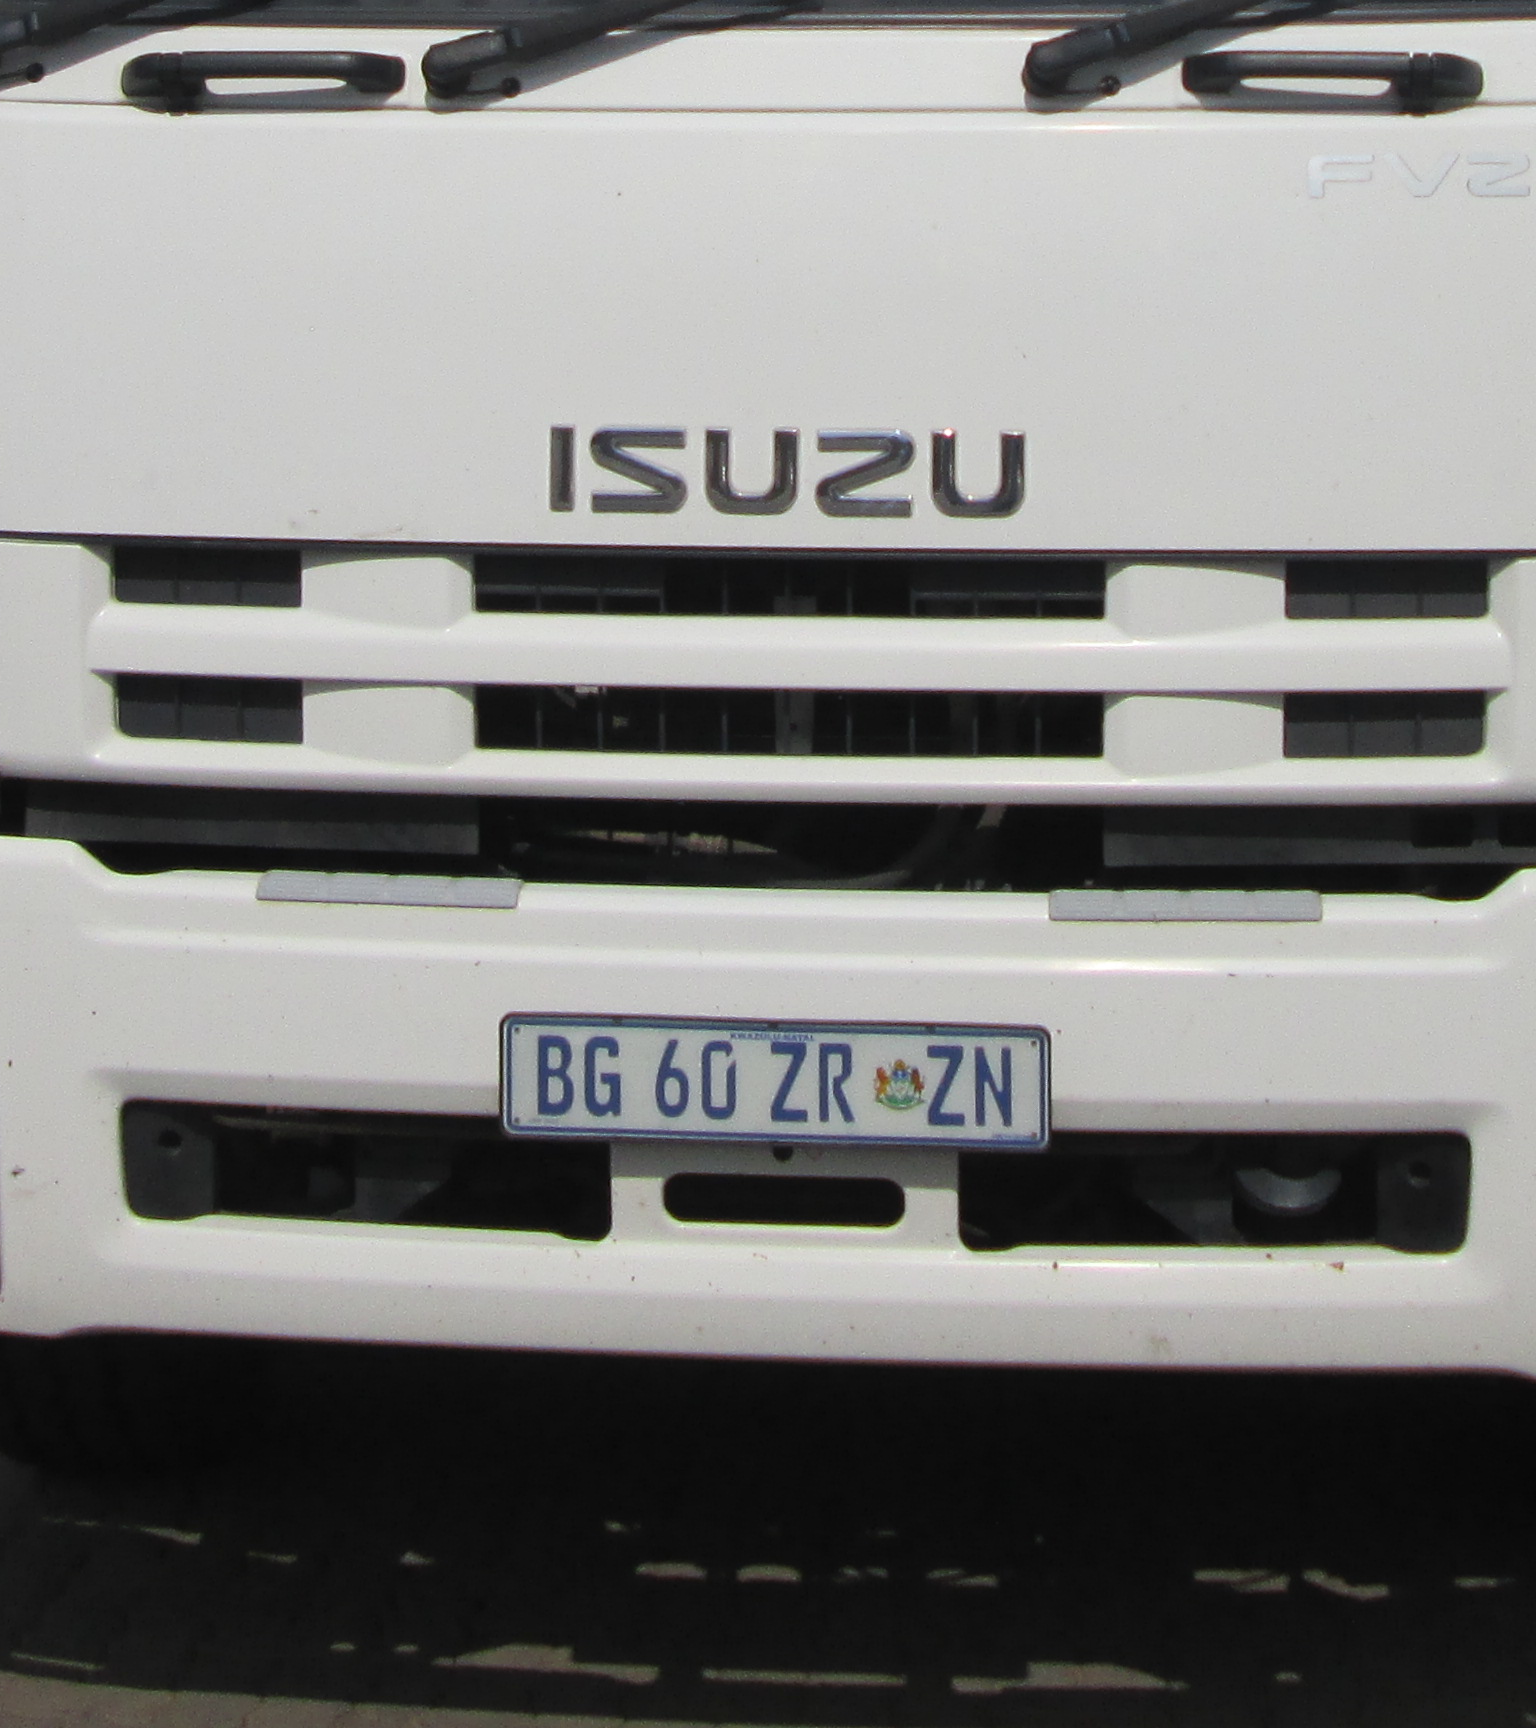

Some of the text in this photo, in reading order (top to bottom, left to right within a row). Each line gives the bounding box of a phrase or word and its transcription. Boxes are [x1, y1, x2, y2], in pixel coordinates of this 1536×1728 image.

[1307, 153, 1531, 200] FVZ
[548, 424, 1026, 518] ISUZU
[537, 1035, 1013, 1127] BG 60 ZR ZN
